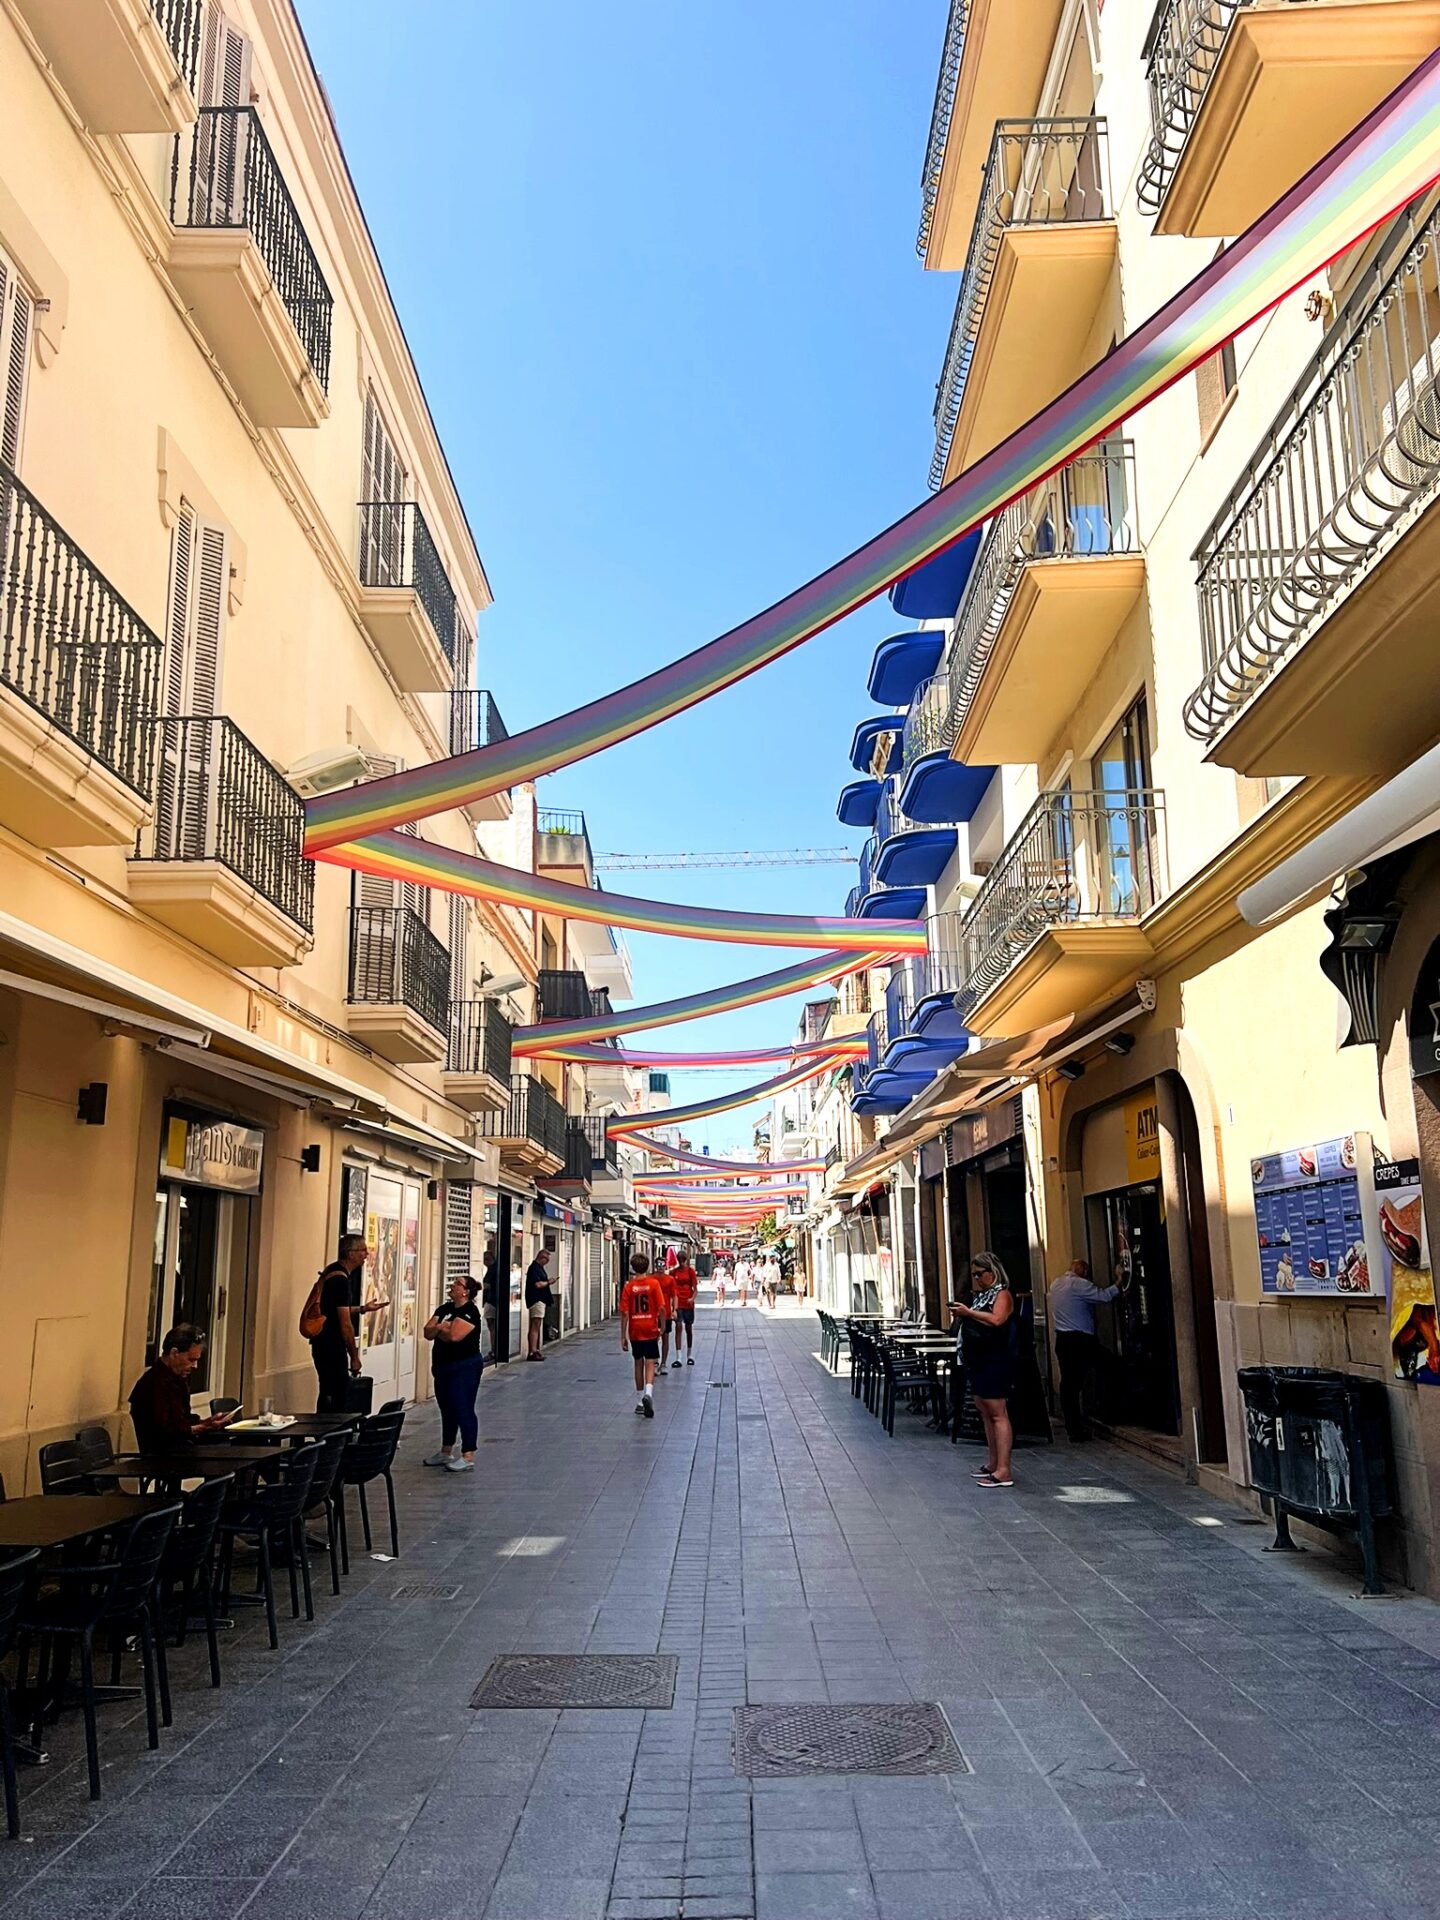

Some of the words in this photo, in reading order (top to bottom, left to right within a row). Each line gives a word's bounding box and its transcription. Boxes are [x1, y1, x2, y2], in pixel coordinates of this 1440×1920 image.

[190, 1124, 233, 1171] pans
[1375, 1165, 1400, 1181] CREPES
[634, 1293, 649, 1313] 16
